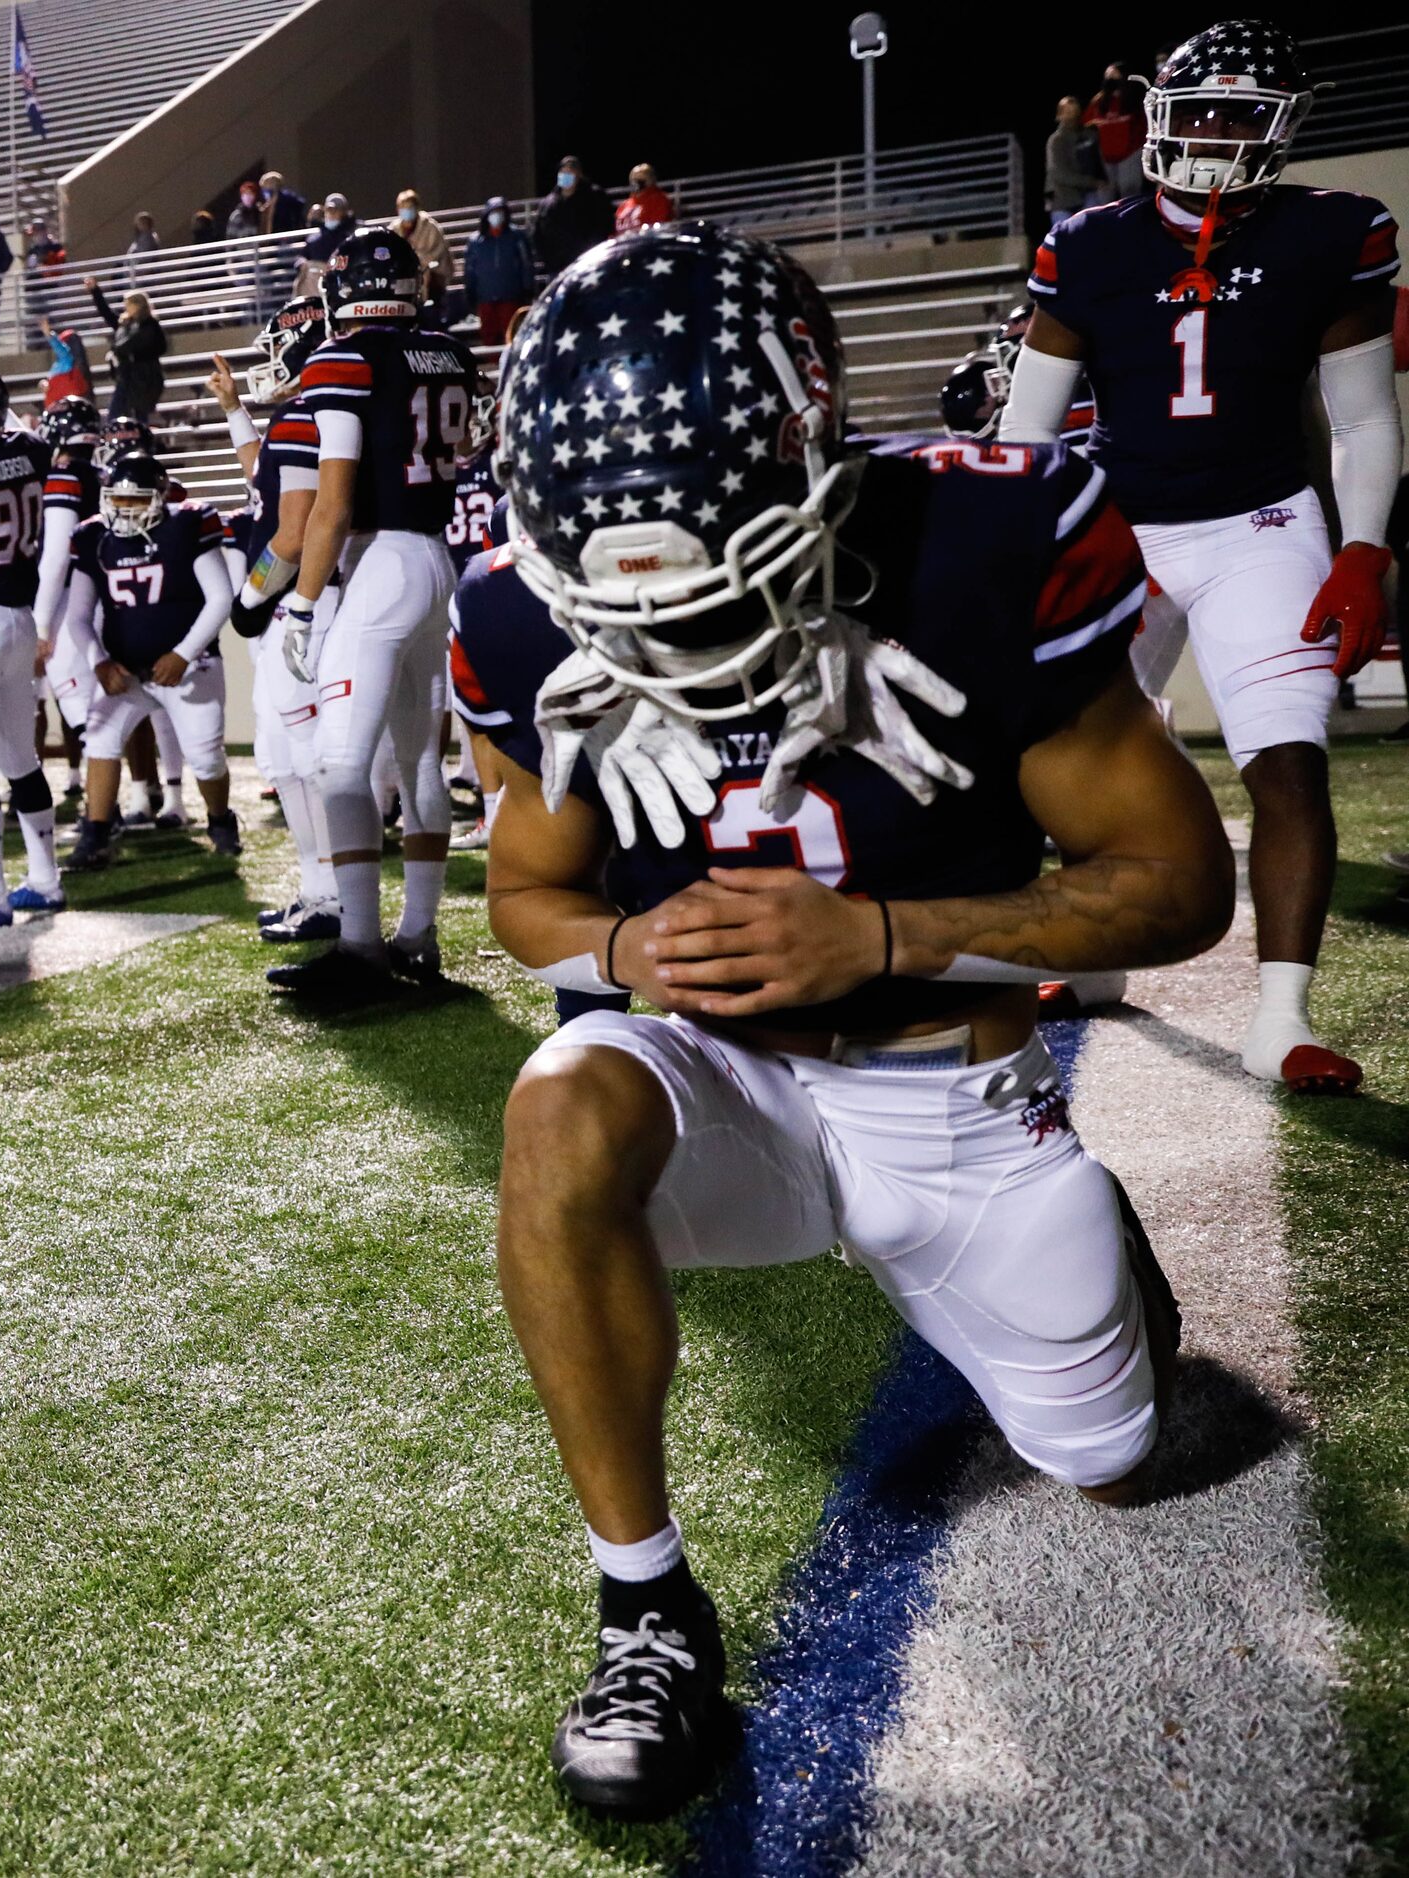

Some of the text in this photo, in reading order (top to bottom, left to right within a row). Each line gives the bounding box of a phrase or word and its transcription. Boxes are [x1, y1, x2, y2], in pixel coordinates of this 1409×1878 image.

[1217, 76, 1239, 86] ONE
[353, 304, 406, 316] Riddell
[403, 349, 465, 375] MARSHALL
[1169, 306, 1216, 418] 1
[403, 384, 470, 485] 19
[1251, 508, 1293, 524] RYAN
[617, 554, 663, 575] ONE
[106, 563, 164, 607] 57
[714, 731, 776, 768] RYA
